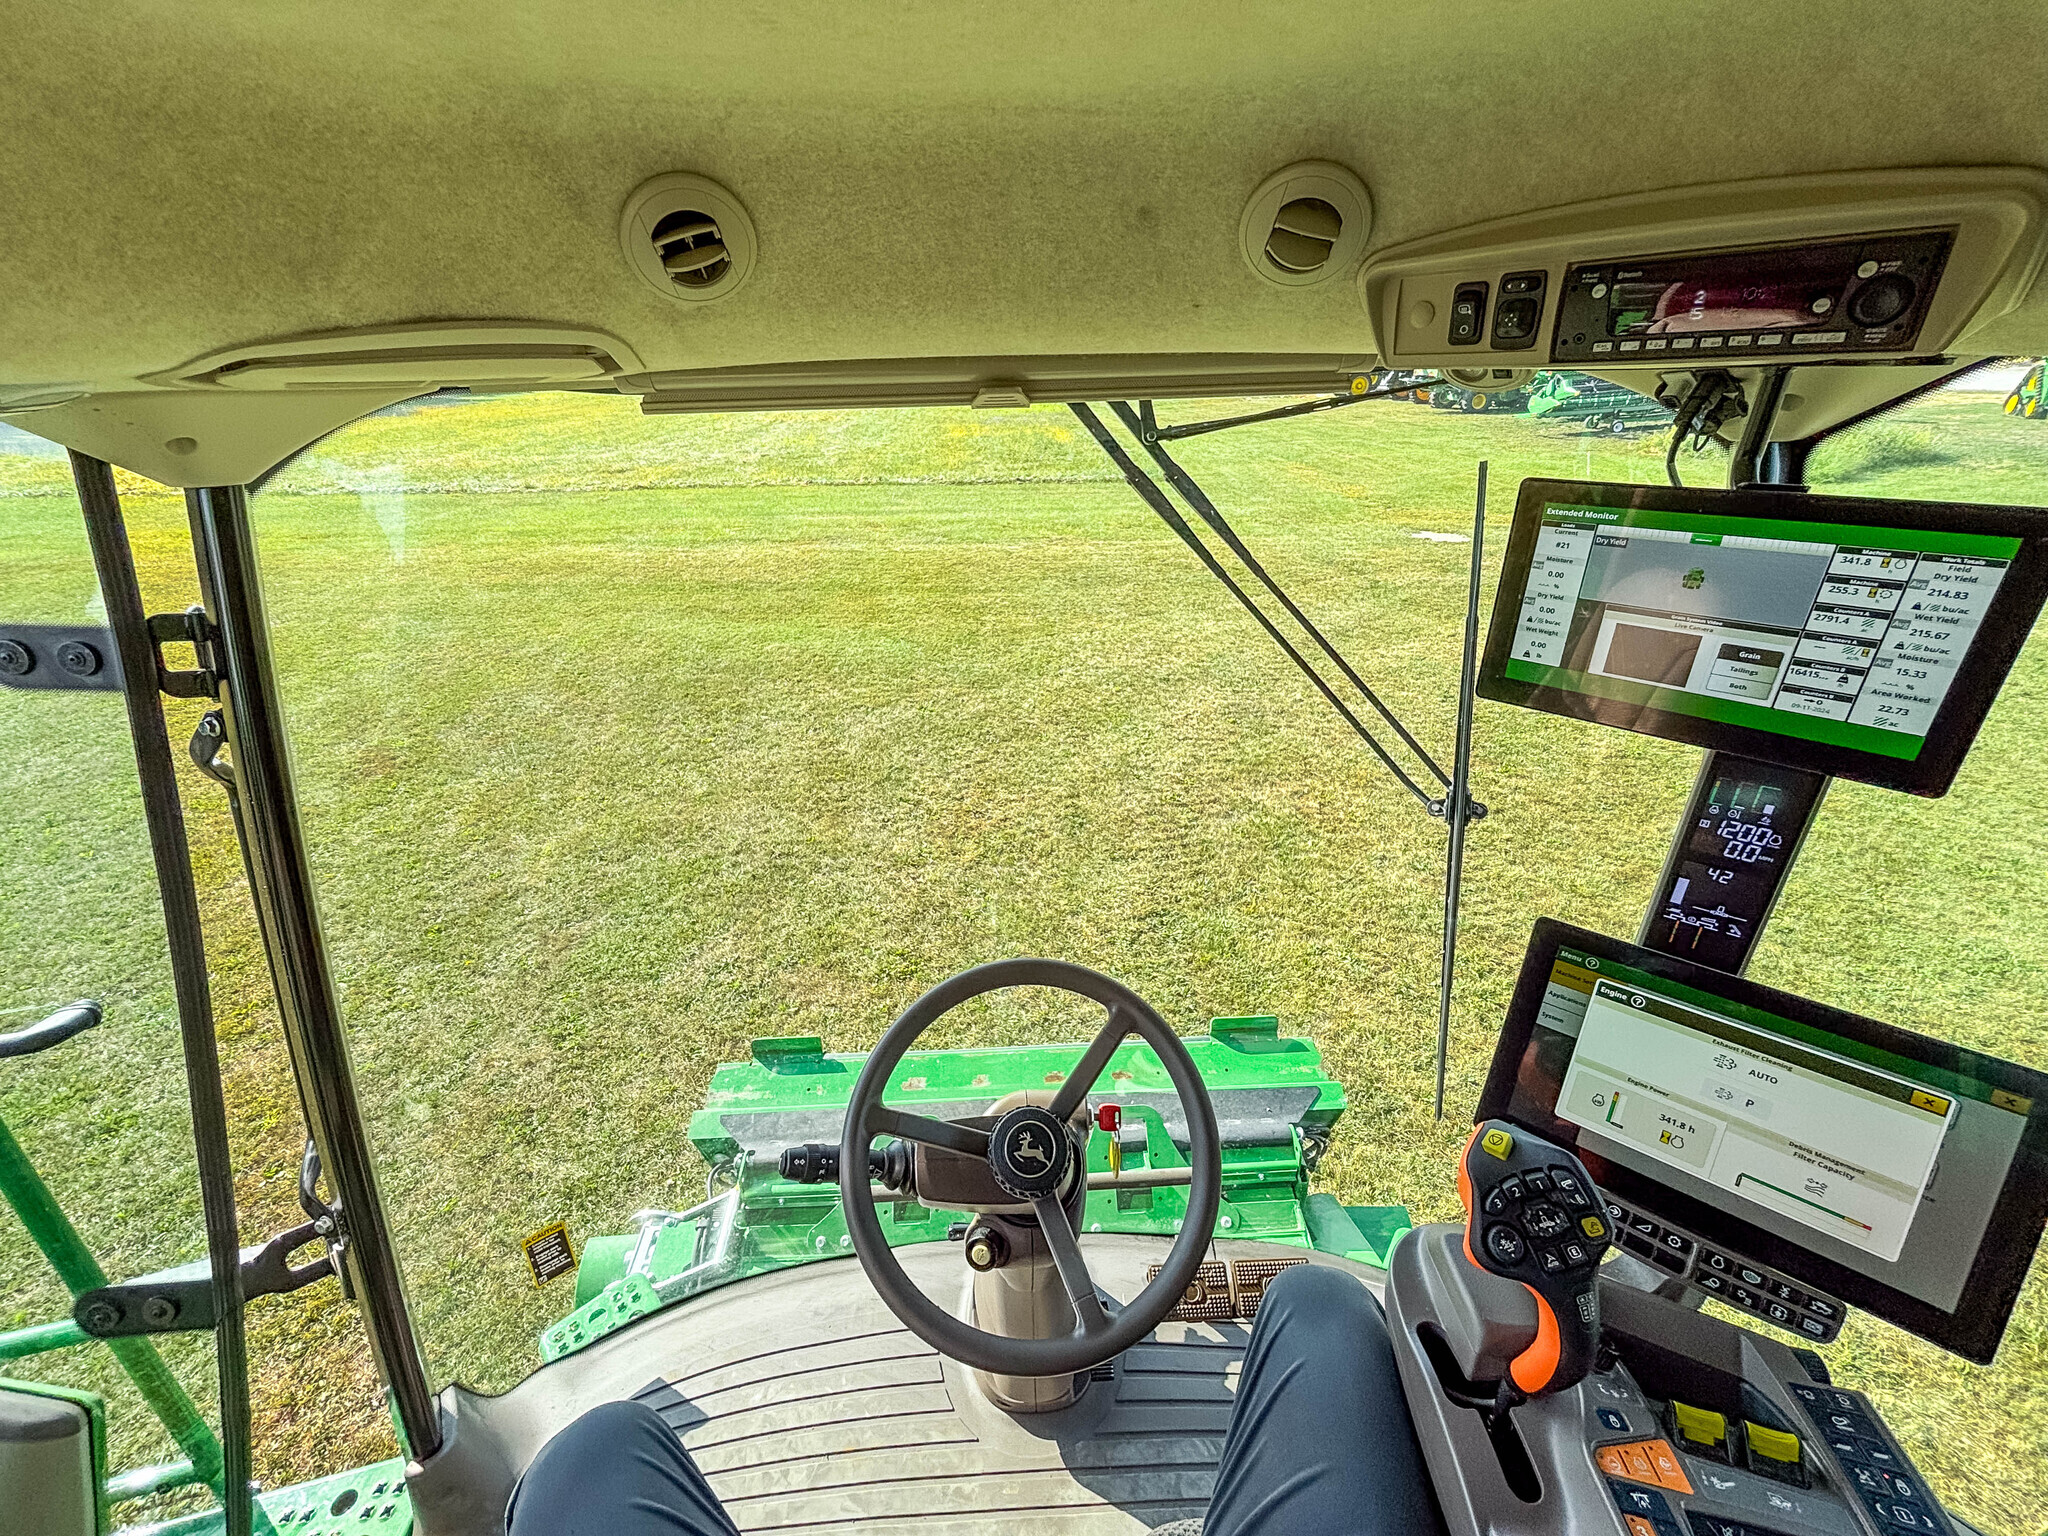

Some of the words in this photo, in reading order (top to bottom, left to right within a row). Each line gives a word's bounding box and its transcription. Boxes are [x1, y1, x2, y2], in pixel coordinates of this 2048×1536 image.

[1546, 507, 1583, 518] Extended
[1584, 511, 1619, 520] Monitor
[1554, 528, 1578, 536] Current
[1555, 541, 1570, 549] #21
[1596, 537, 1608, 545] Dry
[1609, 538, 1628, 546] Yield
[1546, 555, 1574, 564] Moisture
[1840, 555, 1872, 565] 341.8
[1547, 570, 1565, 579] 0.00
[1947, 565, 1973, 573] Field
[1933, 573, 1952, 582] Dry
[1954, 575, 1979, 583] Yield
[1828, 585, 1860, 596] 255.3
[1927, 588, 1969, 600] 214.83
[1537, 592, 1548, 600] Dry
[1549, 593, 1565, 601] Yield
[1539, 606, 1556, 614] 0.00
[1833, 607, 1864, 616] Counters
[1941, 605, 1970, 615] bu/ac
[1813, 613, 1850, 625] 2791.4
[1914, 613, 1934, 621] Wet
[1936, 616, 1960, 625] Yield
[1538, 628, 1559, 636] Weight
[1689, 625, 1714, 633] Camera
[1908, 628, 1951, 640] 215.67
[1530, 640, 1547, 649] 0.00
[1821, 635, 1851, 644] Counters
[1738, 651, 1761, 660] Grain
[1923, 645, 1951, 655] bu/ac
[1897, 653, 1939, 665] Moisture
[1730, 665, 1759, 677] Tailings
[1811, 663, 1840, 672] Counters
[1895, 668, 1927, 679] 15.33
[1728, 682, 1748, 691] Both
[1871, 688, 1893, 697] Area
[1894, 692, 1931, 704] Worked
[1790, 702, 1831, 714] 09-11-2024
[1877, 704, 1910, 716] 22.73
[1716, 820, 1773, 846] 1200
[1723, 840, 1762, 863] 0.0
[1708, 867, 1735, 885] 42
[1560, 950, 1582, 962] Menu
[1548, 990, 1587, 1008] Applications
[1600, 986, 1628, 1001] Engine
[1541, 1011, 1564, 1024] System
[1712, 1038, 1740, 1053] Exhaust
[1740, 1049, 1760, 1060] Filter
[1761, 1056, 1793, 1072] Cleaning
[1748, 1069, 1779, 1085] AUTO
[1627, 1077, 1649, 1089] Engine
[1649, 1085, 1670, 1097] Power
[1745, 1099, 1755, 1108] P
[1658, 1113, 1687, 1130] 341.8
[1688, 1125, 1696, 1134] h
[1788, 1140, 1813, 1155] Debris
[1814, 1150, 1866, 1176] Management
[1793, 1151, 1816, 1165] Filter
[1817, 1160, 1856, 1181] Capacity
[1535, 1180, 1544, 1190] 1
[1511, 1187, 1521, 1197] 2
[1493, 1198, 1502, 1209] 3
[531, 1222, 563, 1242] CAUTION
